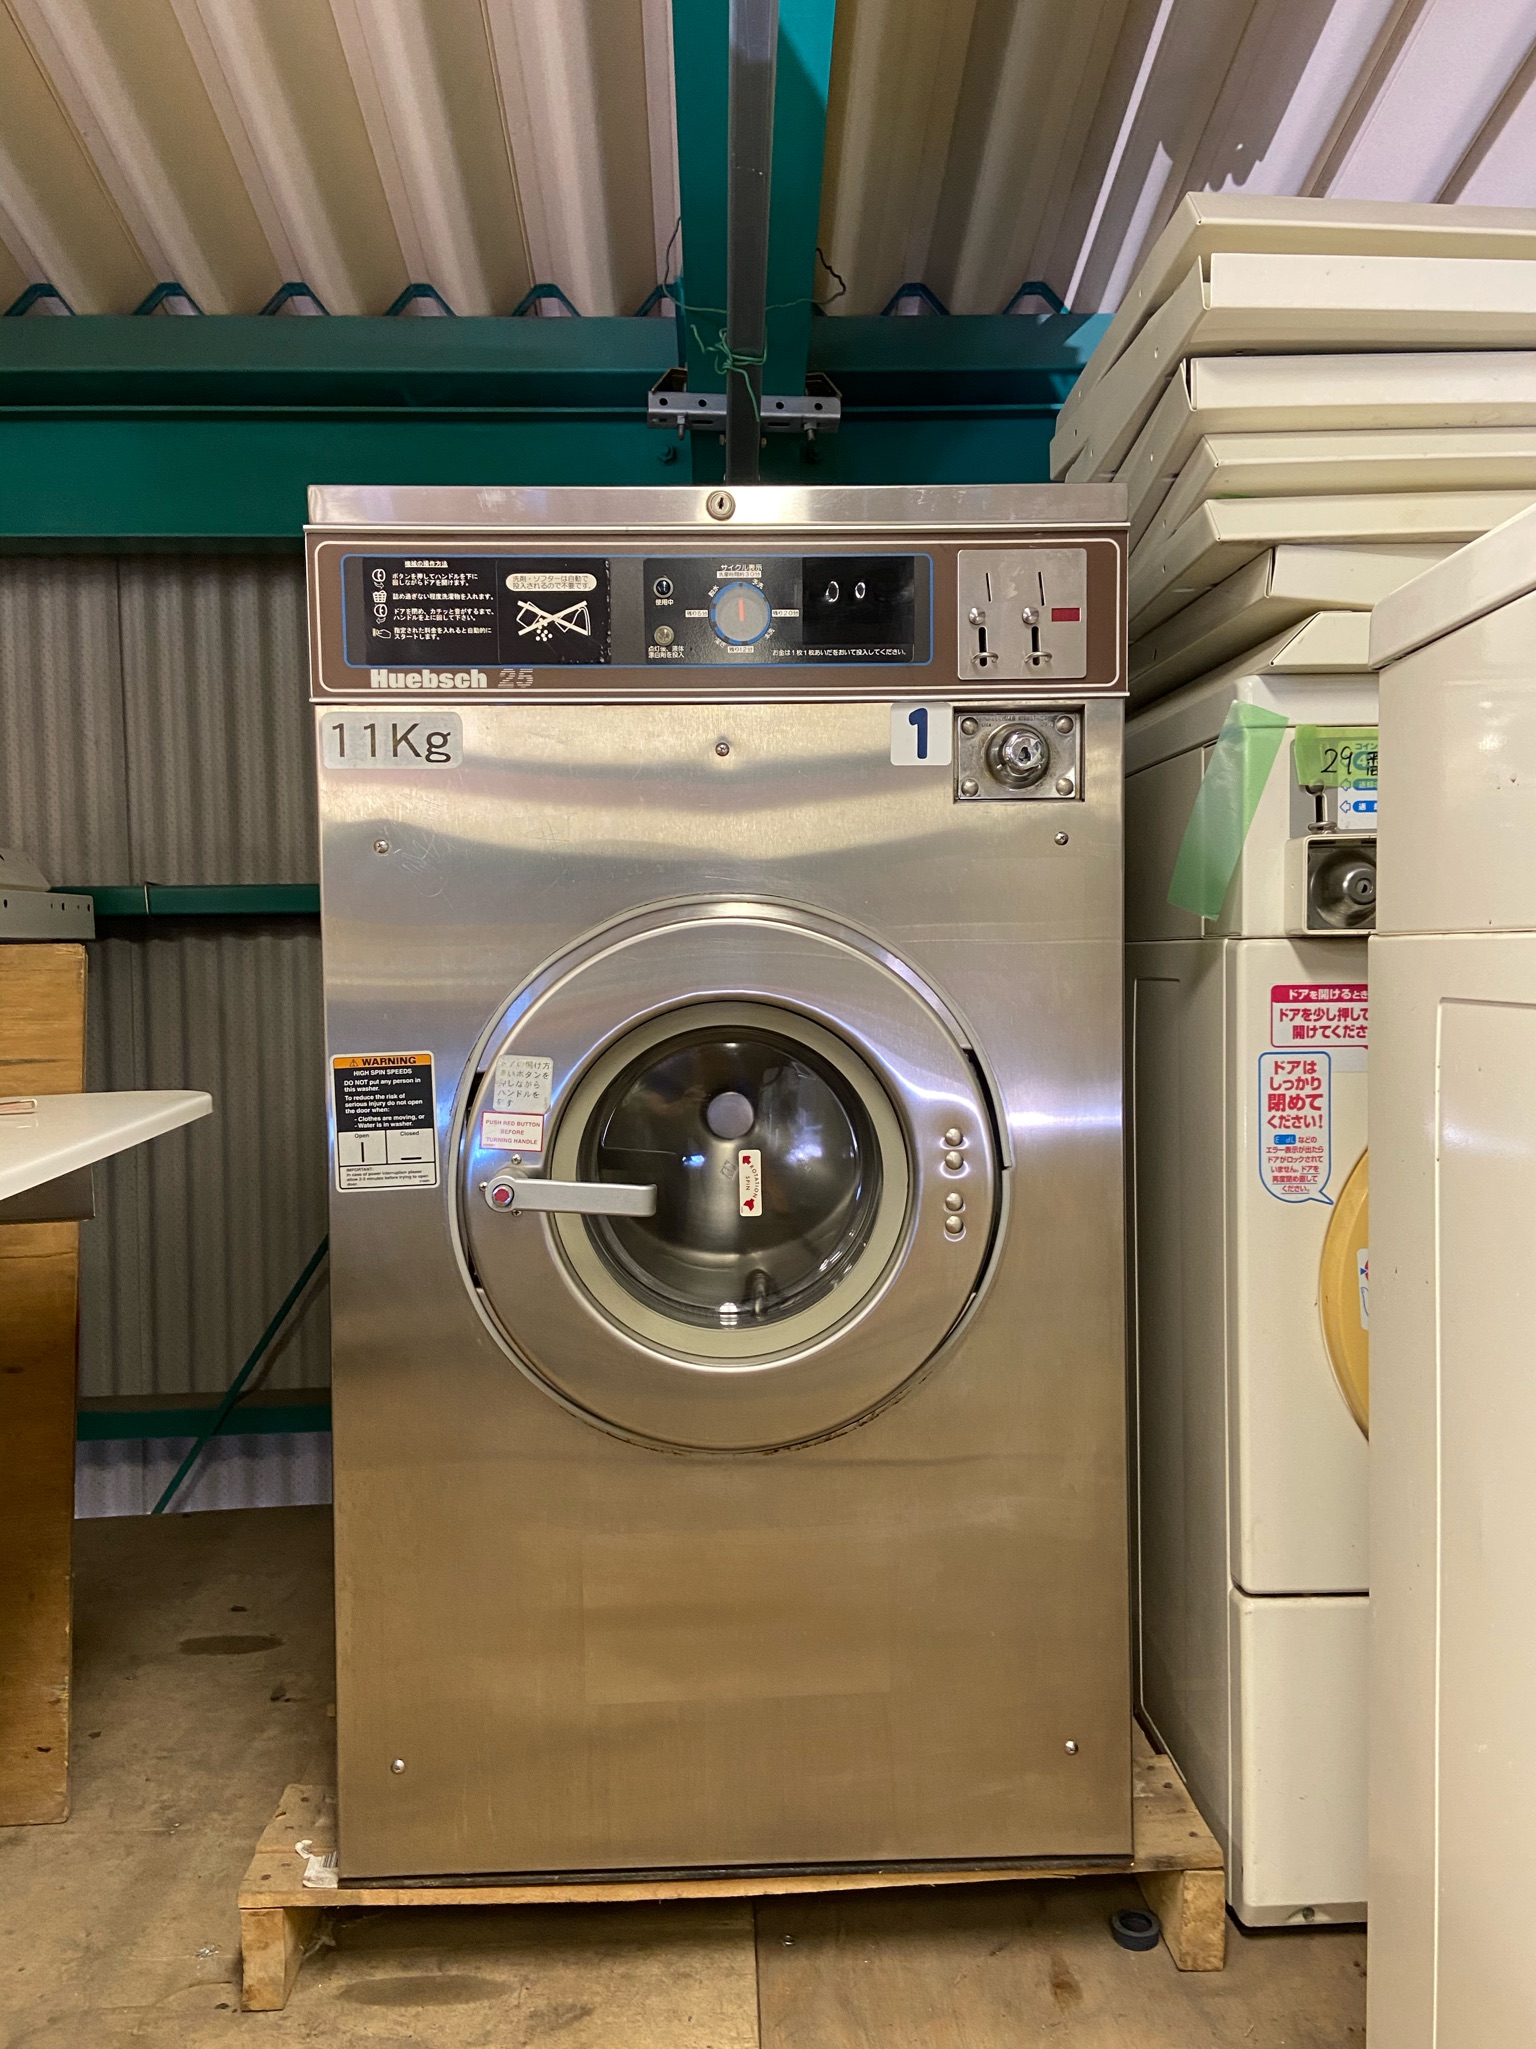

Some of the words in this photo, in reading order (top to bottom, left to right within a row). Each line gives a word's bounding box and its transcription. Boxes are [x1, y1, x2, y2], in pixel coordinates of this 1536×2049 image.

[370, 668, 488, 688] Huebsch
[498, 668, 534, 688] 25
[908, 707, 928, 760] 1
[332, 723, 451, 763] 11Kg
[362, 1056, 416, 1066] WARNING
[1274, 1060, 1318, 1075] ドアは
[1270, 1076, 1322, 1091] しっかり
[368, 1100, 386, 1108] injury
[1268, 1093, 1324, 1112] 閉めて
[486, 1136, 512, 1144] TURNING
[1298, 1136, 1318, 1144] などの
[1266, 1146, 1324, 1154] エラー表示が出たら
[1268, 1156, 1324, 1164] ドアがロックされて
[750, 1164, 760, 1198] ROTATION
